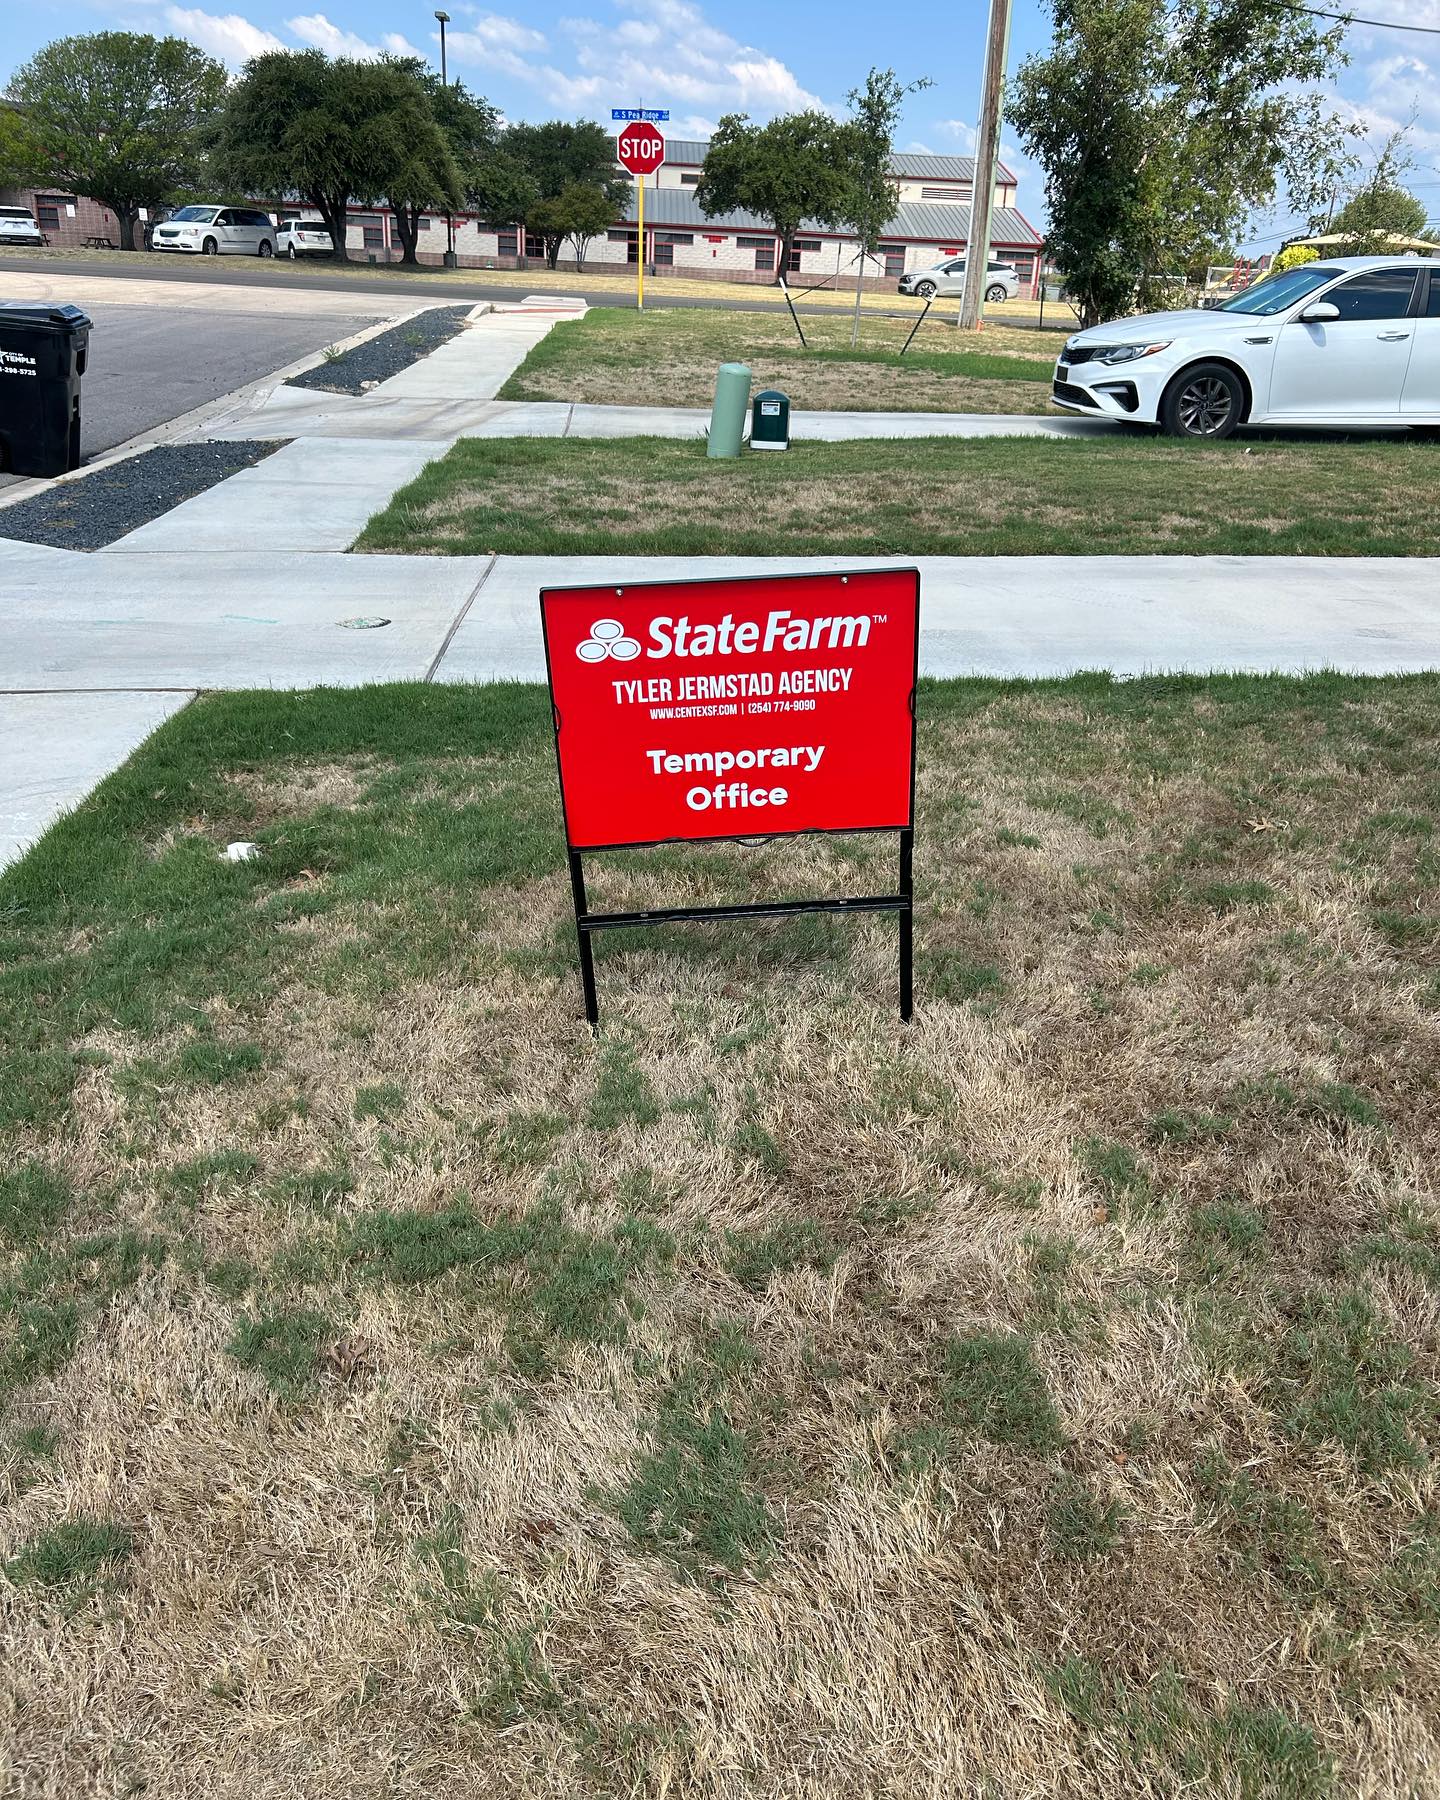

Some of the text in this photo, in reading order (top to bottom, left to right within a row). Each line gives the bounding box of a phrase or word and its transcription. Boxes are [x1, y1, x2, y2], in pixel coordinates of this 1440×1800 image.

[622, 111, 626, 119] S
[628, 111, 640, 119] Pea
[642, 111, 659, 121] Ridge
[621, 138, 662, 159] STOP
[5, 355, 36, 364] TEMPLE
[612, 667, 853, 704] TYLER JERMSTAD AGENCY
[649, 703, 738, 720] WWW.CENTEXSF.COM
[748, 701, 772, 714] (254)
[773, 699, 816, 713] 774-9090
[646, 745, 827, 777] Temporary
[686, 782, 789, 811] Office
